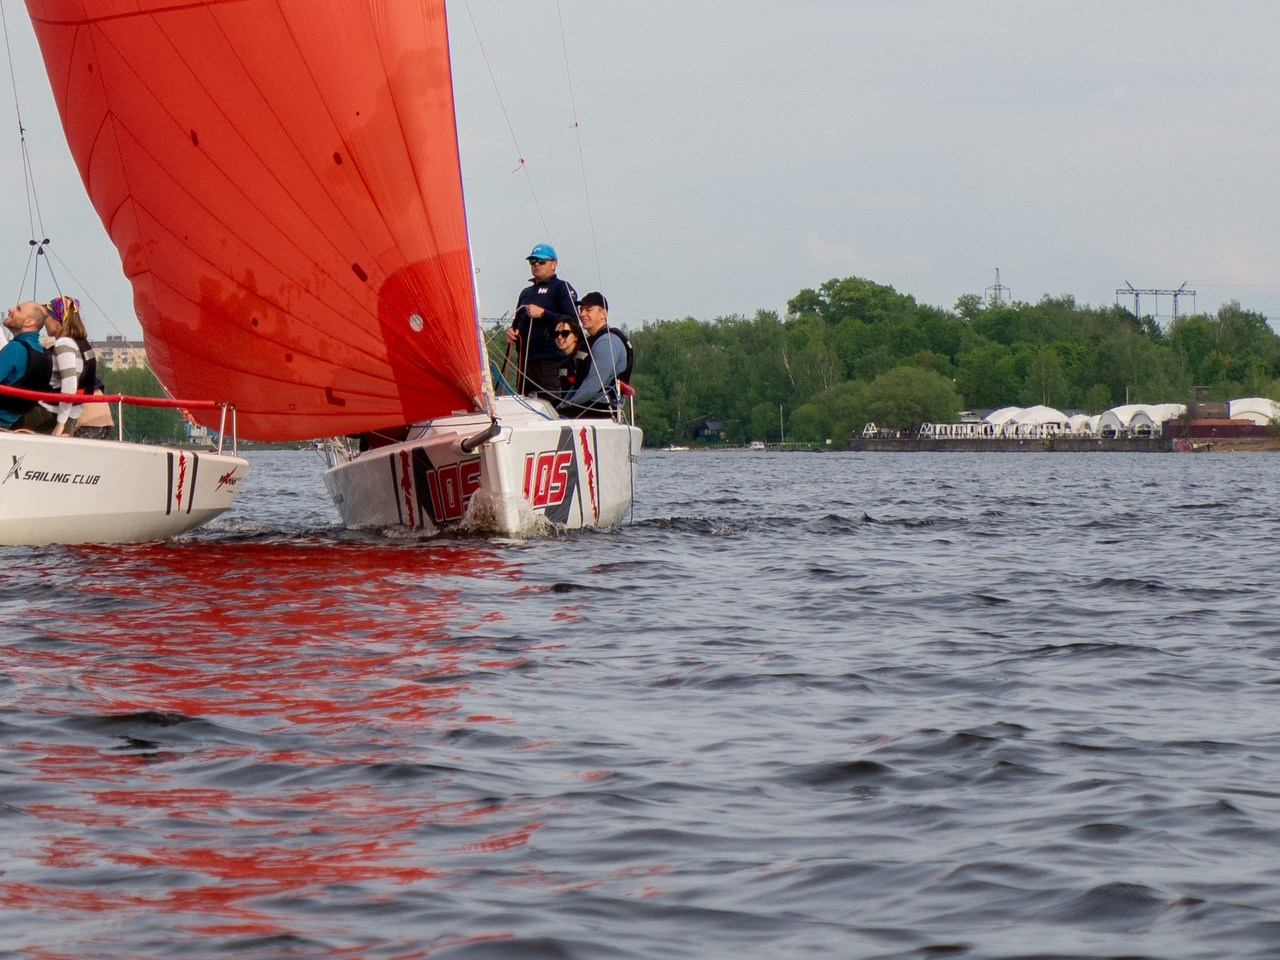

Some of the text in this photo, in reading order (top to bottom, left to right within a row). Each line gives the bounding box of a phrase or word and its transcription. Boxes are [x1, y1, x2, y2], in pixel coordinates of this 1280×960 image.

[22, 470, 71, 484] SAILING
[72, 474, 101, 485] CLUB
[522, 450, 573, 510] 105
